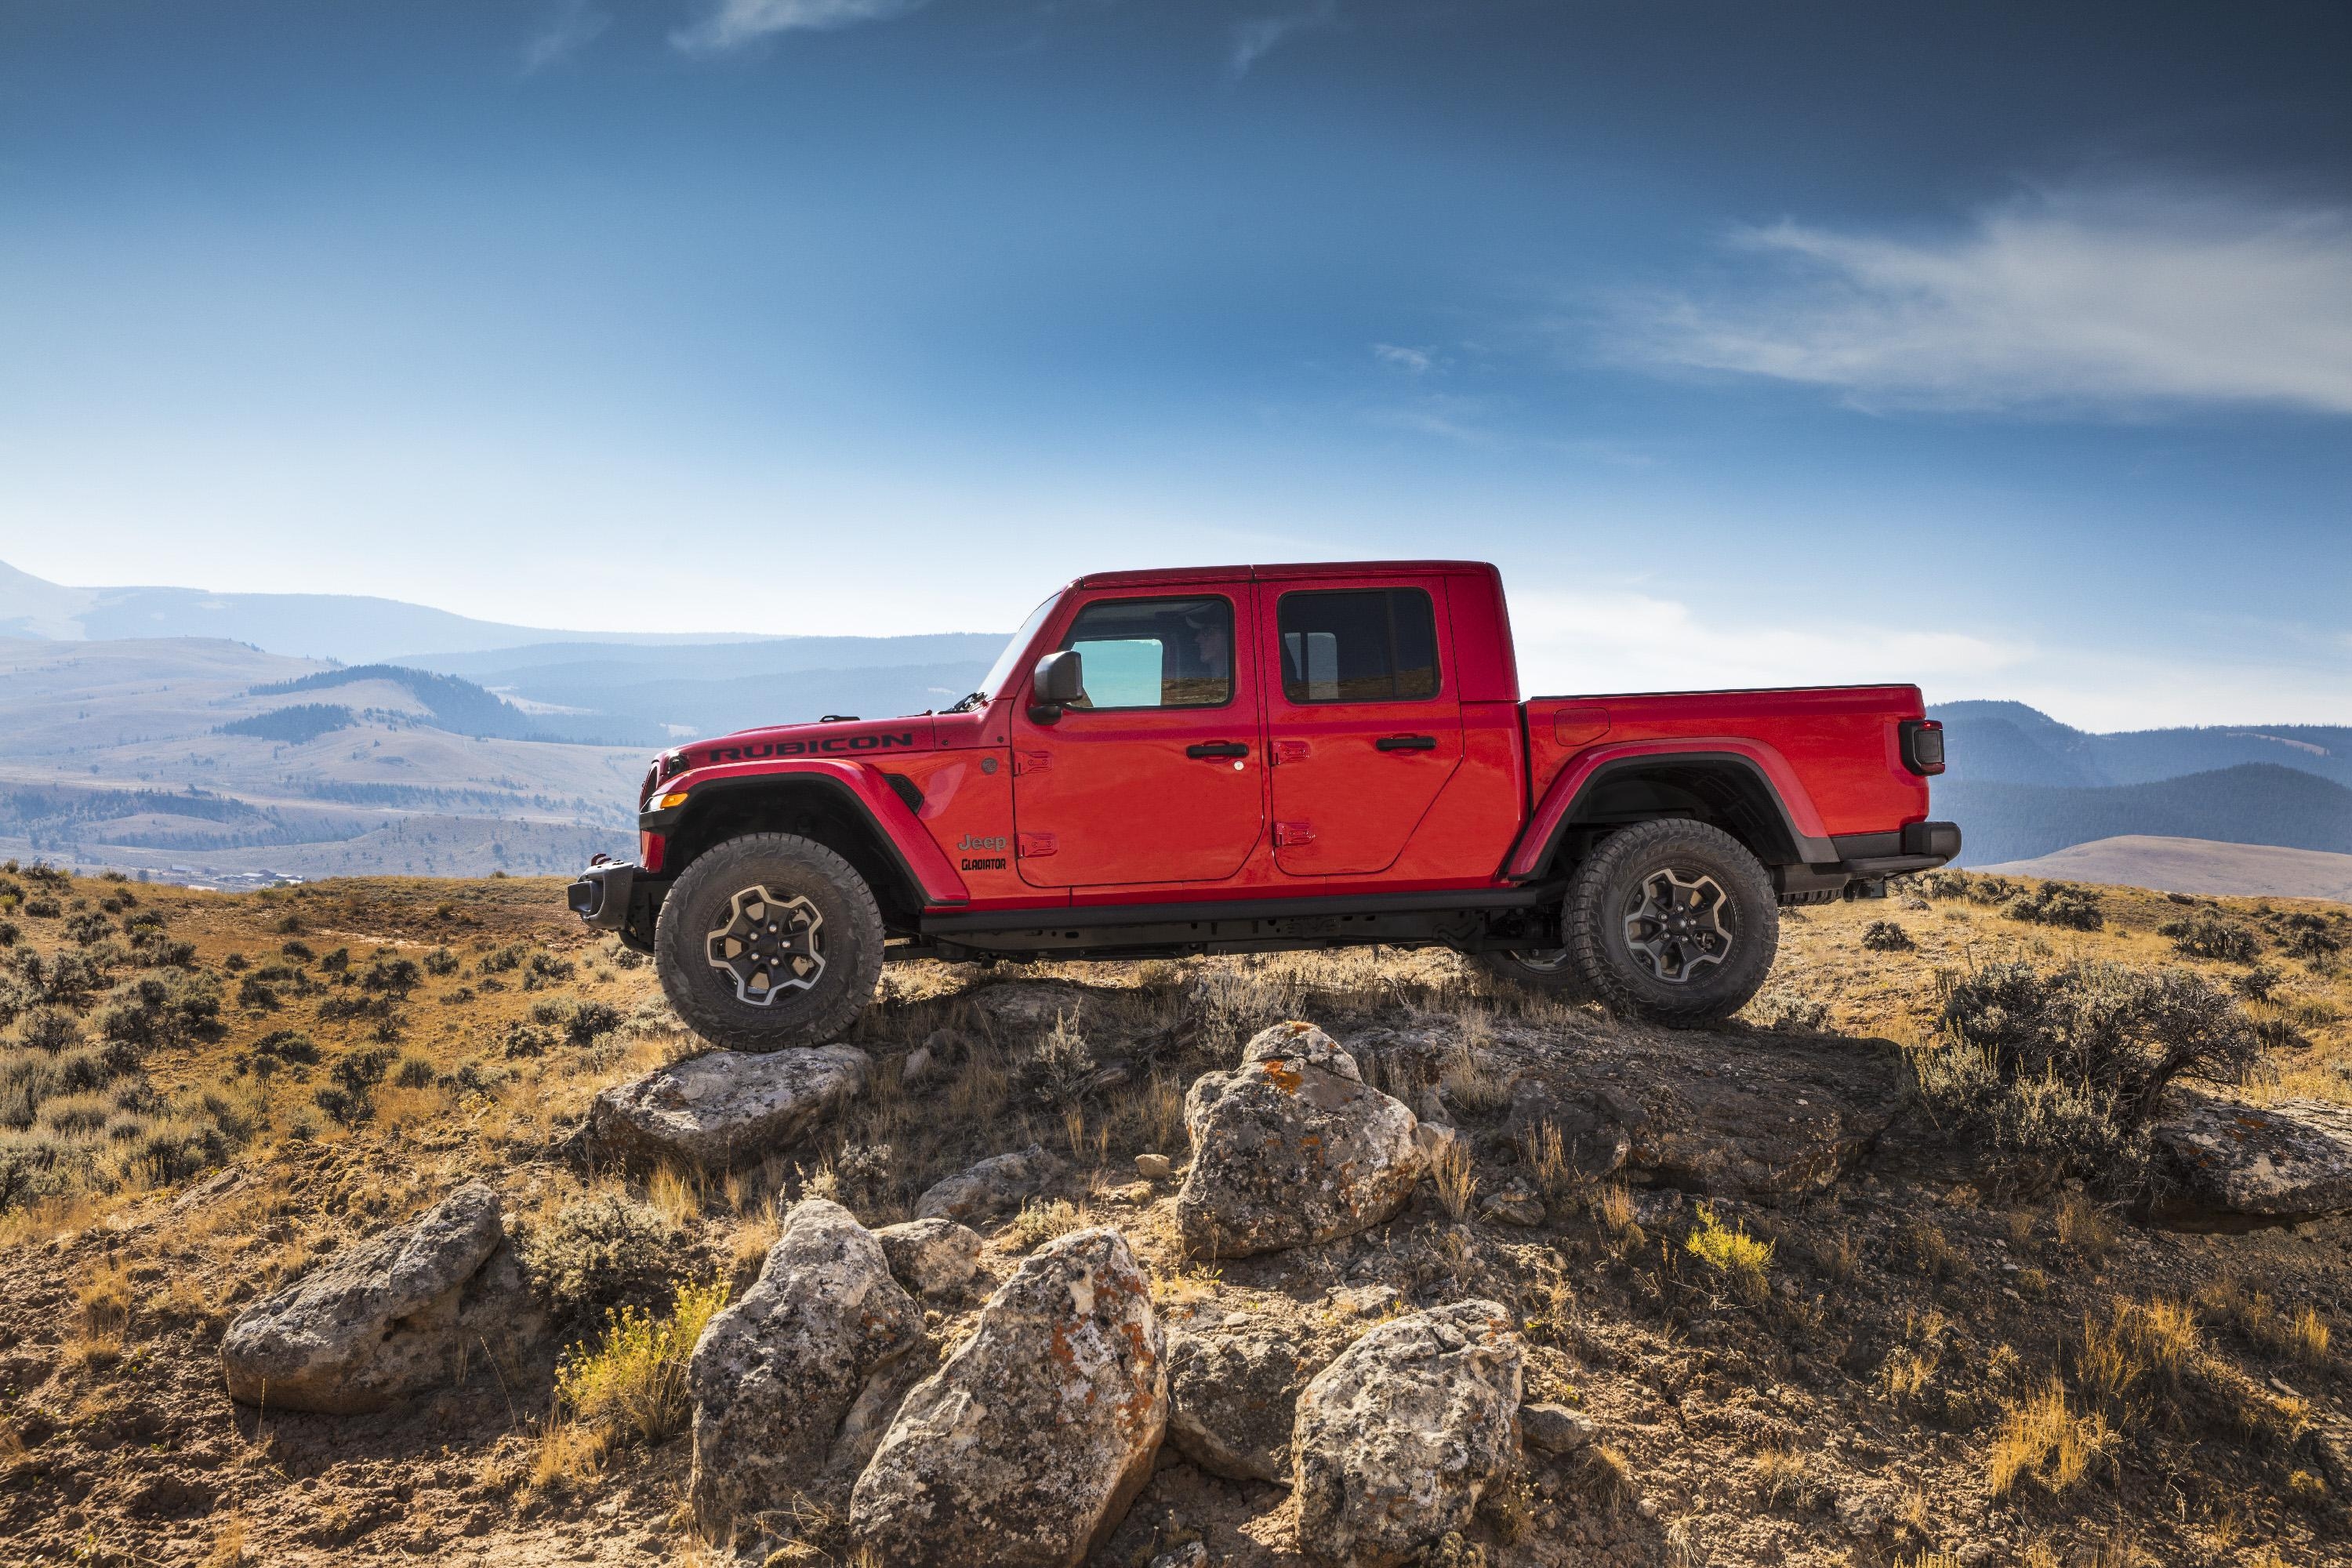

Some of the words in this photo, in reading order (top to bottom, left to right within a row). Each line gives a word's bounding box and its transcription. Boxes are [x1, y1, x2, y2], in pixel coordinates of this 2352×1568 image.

[709, 733, 913, 762] RUBICON
[958, 834, 1007, 852] Jeep
[961, 858, 1006, 870] GLADIATOR
